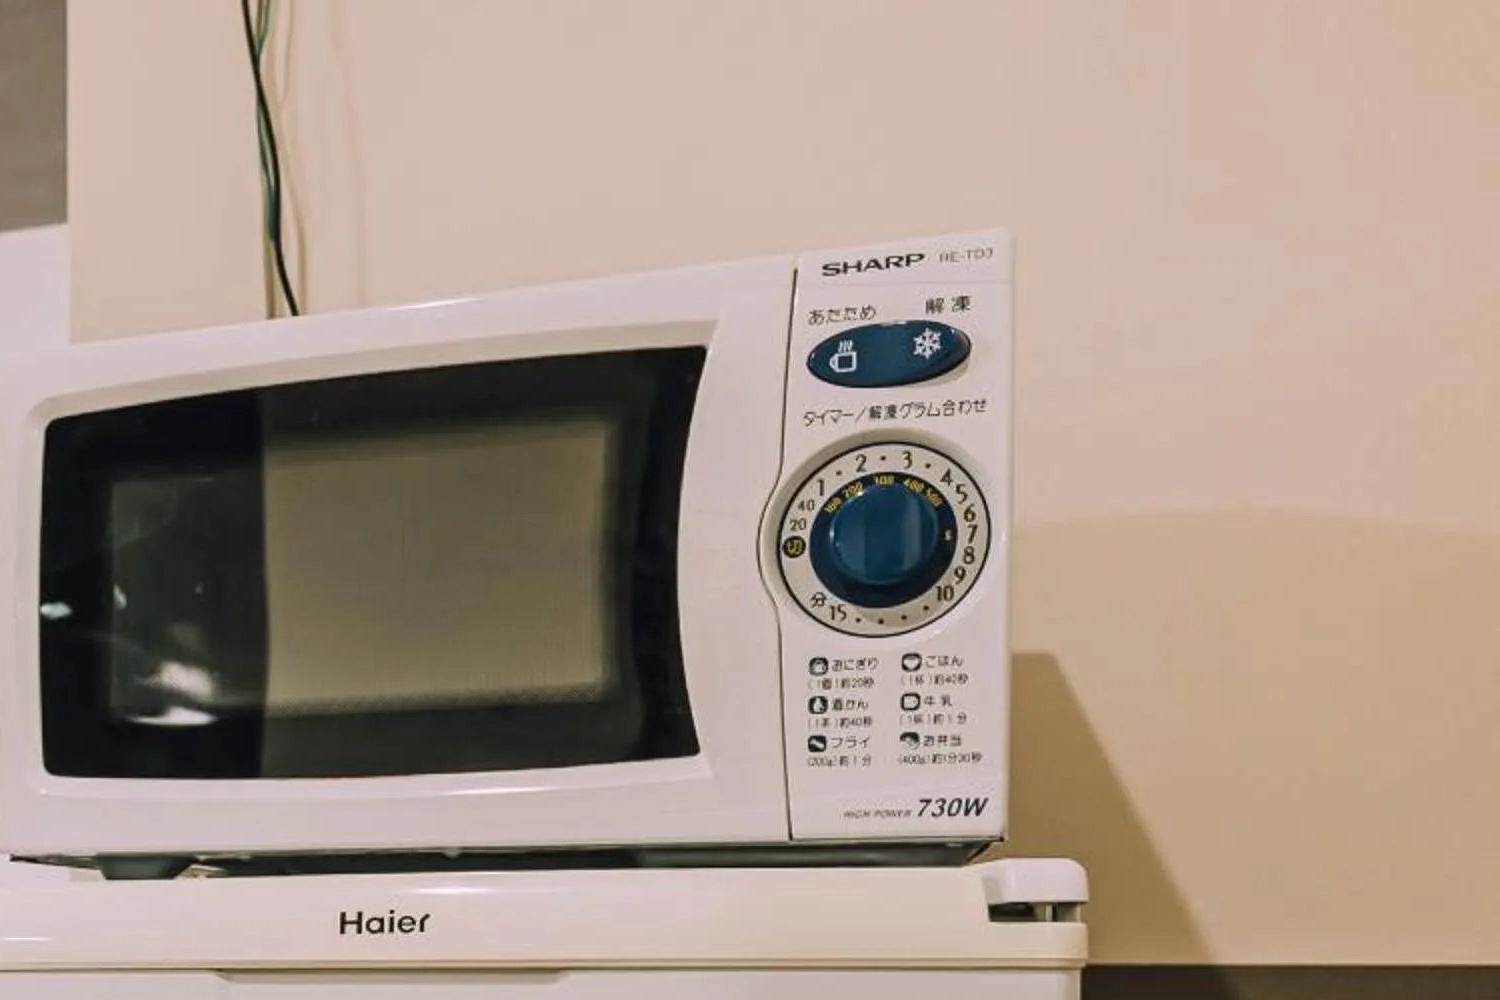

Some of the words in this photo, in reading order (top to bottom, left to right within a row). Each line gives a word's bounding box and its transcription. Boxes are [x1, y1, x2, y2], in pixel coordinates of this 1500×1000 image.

[821, 252, 925, 277] SHARP
[808, 304, 877, 326] あたため
[855, 454, 867, 472] 2
[902, 451, 913, 469] 3
[940, 469, 953, 485] 4
[818, 479, 825, 496] 1
[955, 484, 968, 504] 5
[798, 499, 815, 512] 40
[963, 504, 976, 522] 6
[790, 517, 807, 531] 20
[967, 523, 978, 544] 7
[963, 546, 975, 565] 8
[954, 566, 966, 584] 9
[936, 585, 954, 602] 10
[830, 603, 847, 621] 15
[832, 657, 879, 672] おにぎり
[831, 736, 870, 748] フライ
[917, 797, 989, 817] 730W
[340, 909, 430, 934] Haier
